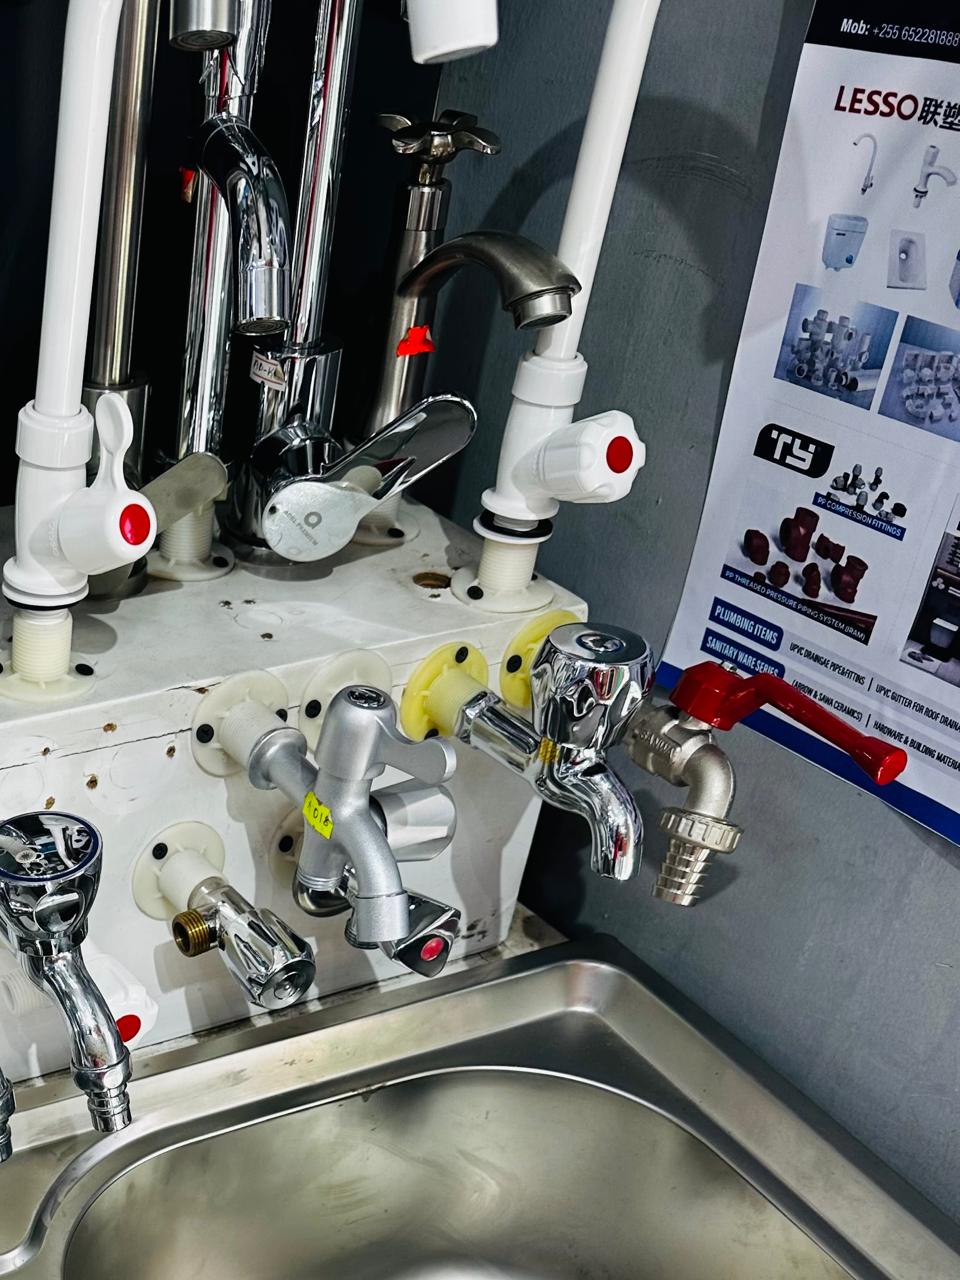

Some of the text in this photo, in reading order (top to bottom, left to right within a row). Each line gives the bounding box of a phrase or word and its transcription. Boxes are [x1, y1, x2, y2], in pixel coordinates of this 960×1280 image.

[840, 18, 870, 35] Mob:
[872, 23, 900, 39] +255
[834, 85, 918, 121] LESSO
[771, 429, 816, 471] TY
[826, 500, 872, 526] COMPRESSION
[871, 518, 902, 537] FITTINGS
[735, 574, 766, 594] THREADED
[766, 588, 798, 609] PRESSURE
[797, 603, 819, 618] PIPING
[819, 612, 844, 631] SYSTEM
[714, 605, 779, 645] PLUMBING ITEMS
[706, 636, 738, 660] SANITARY
[737, 650, 757, 669] WARE
[875, 684, 891, 698] UPVC
[890, 691, 913, 709] GUTTER
[911, 701, 925, 714] FOR
[923, 707, 941, 721] ROOF
[833, 700, 864, 723] CERAMICS)
[873, 720, 905, 743] HARDWARE
[908, 738, 937, 759] BUILDING
